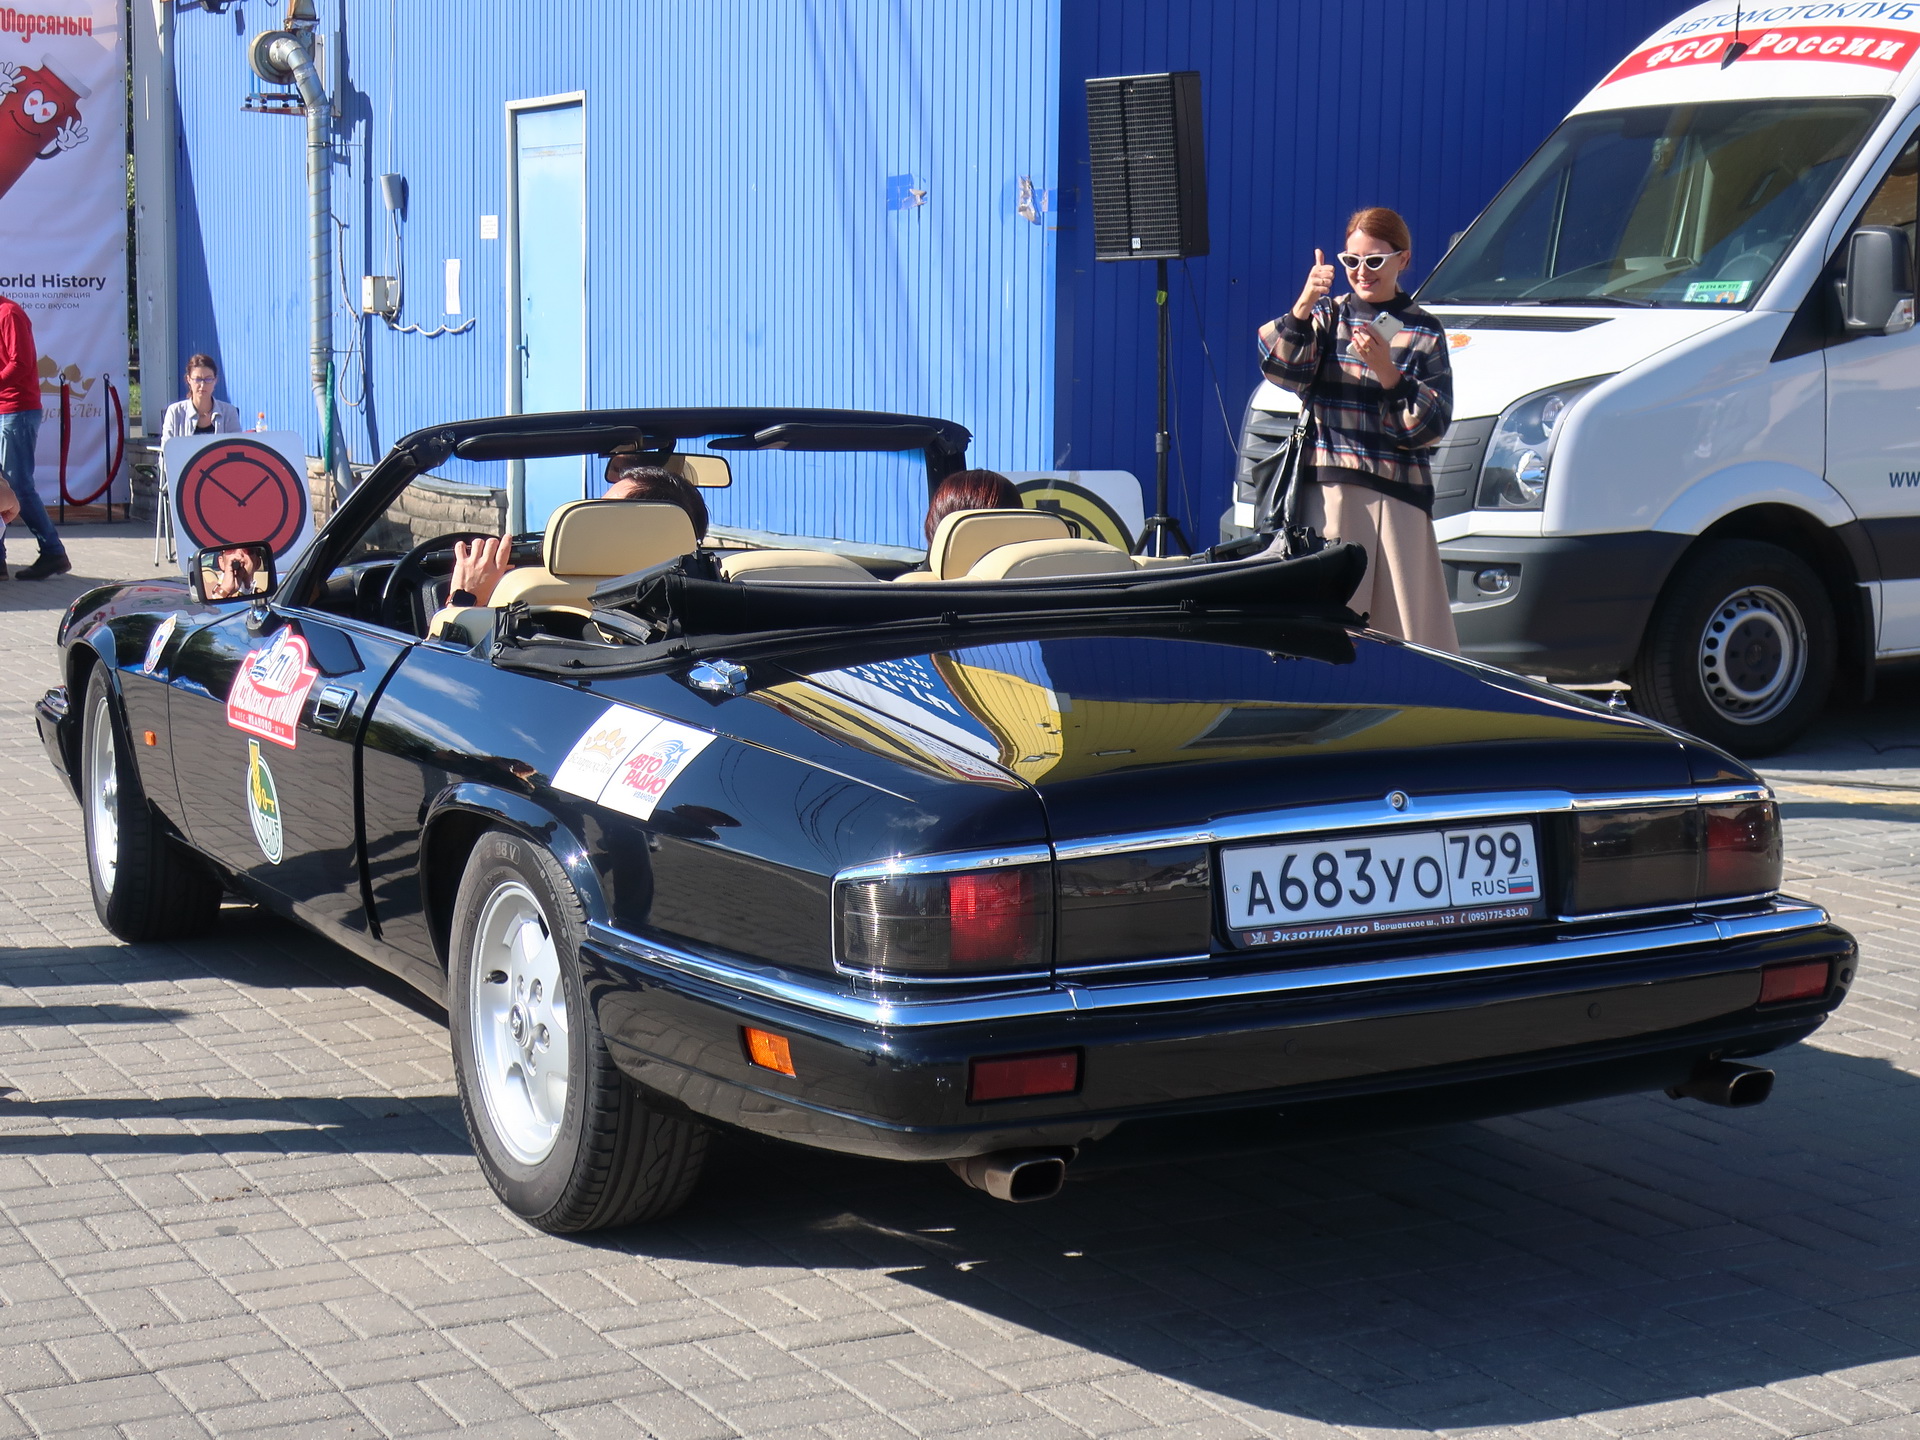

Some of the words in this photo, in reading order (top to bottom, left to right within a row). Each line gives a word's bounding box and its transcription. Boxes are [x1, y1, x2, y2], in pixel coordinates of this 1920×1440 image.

[1662, 2, 1919, 38] АВТОМОТОКЛУБ
[1646, 37, 1724, 68] ФСО
[42, 274, 106, 291] History
[42, 292, 91, 300] коллекция
[48, 302, 80, 310] вкусом
[624, 753, 663, 774] АВТО
[621, 769, 667, 795] РАДИО
[1449, 832, 1521, 879] 799
[1247, 848, 1443, 916] А683УО
[1472, 880, 1507, 897] RUS
[1272, 925, 1369, 942] ЭкзотикАвто
[1441, 915, 1455, 925] 132
